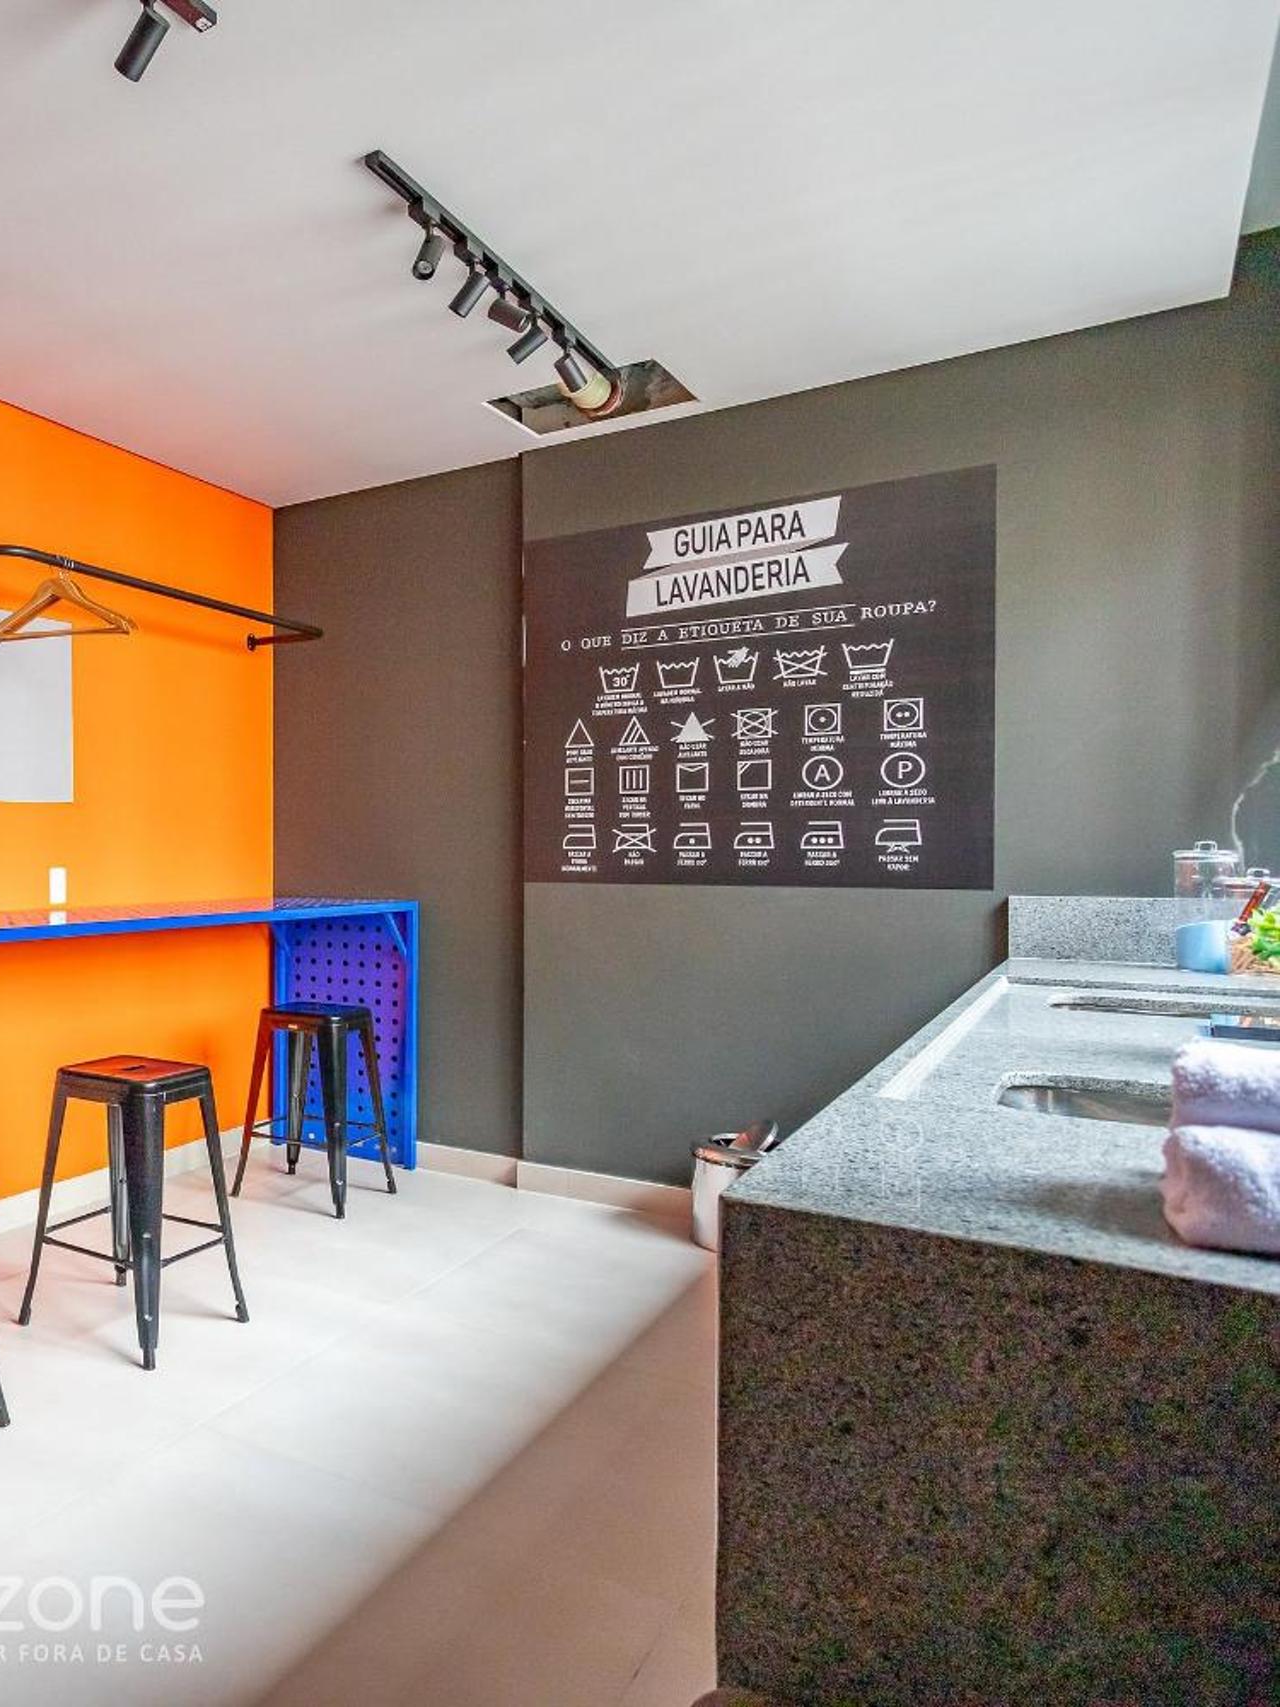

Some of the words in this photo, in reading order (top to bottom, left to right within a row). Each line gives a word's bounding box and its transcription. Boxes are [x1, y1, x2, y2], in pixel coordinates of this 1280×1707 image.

[674, 522, 731, 557] GUIA
[737, 510, 805, 547] PARA
[656, 556, 810, 606] LAVANDERIA
[561, 640, 571, 651] O
[581, 636, 612, 650] QUE
[621, 631, 648, 645] DIZ
[657, 630, 669, 641] A
[678, 619, 764, 640] ETIQUETA
[775, 615, 800, 629] DE
[812, 610, 847, 625] SUA
[860, 600, 936, 620] ROUPA?
[814, 764, 831, 782] A
[898, 761, 913, 779] P
